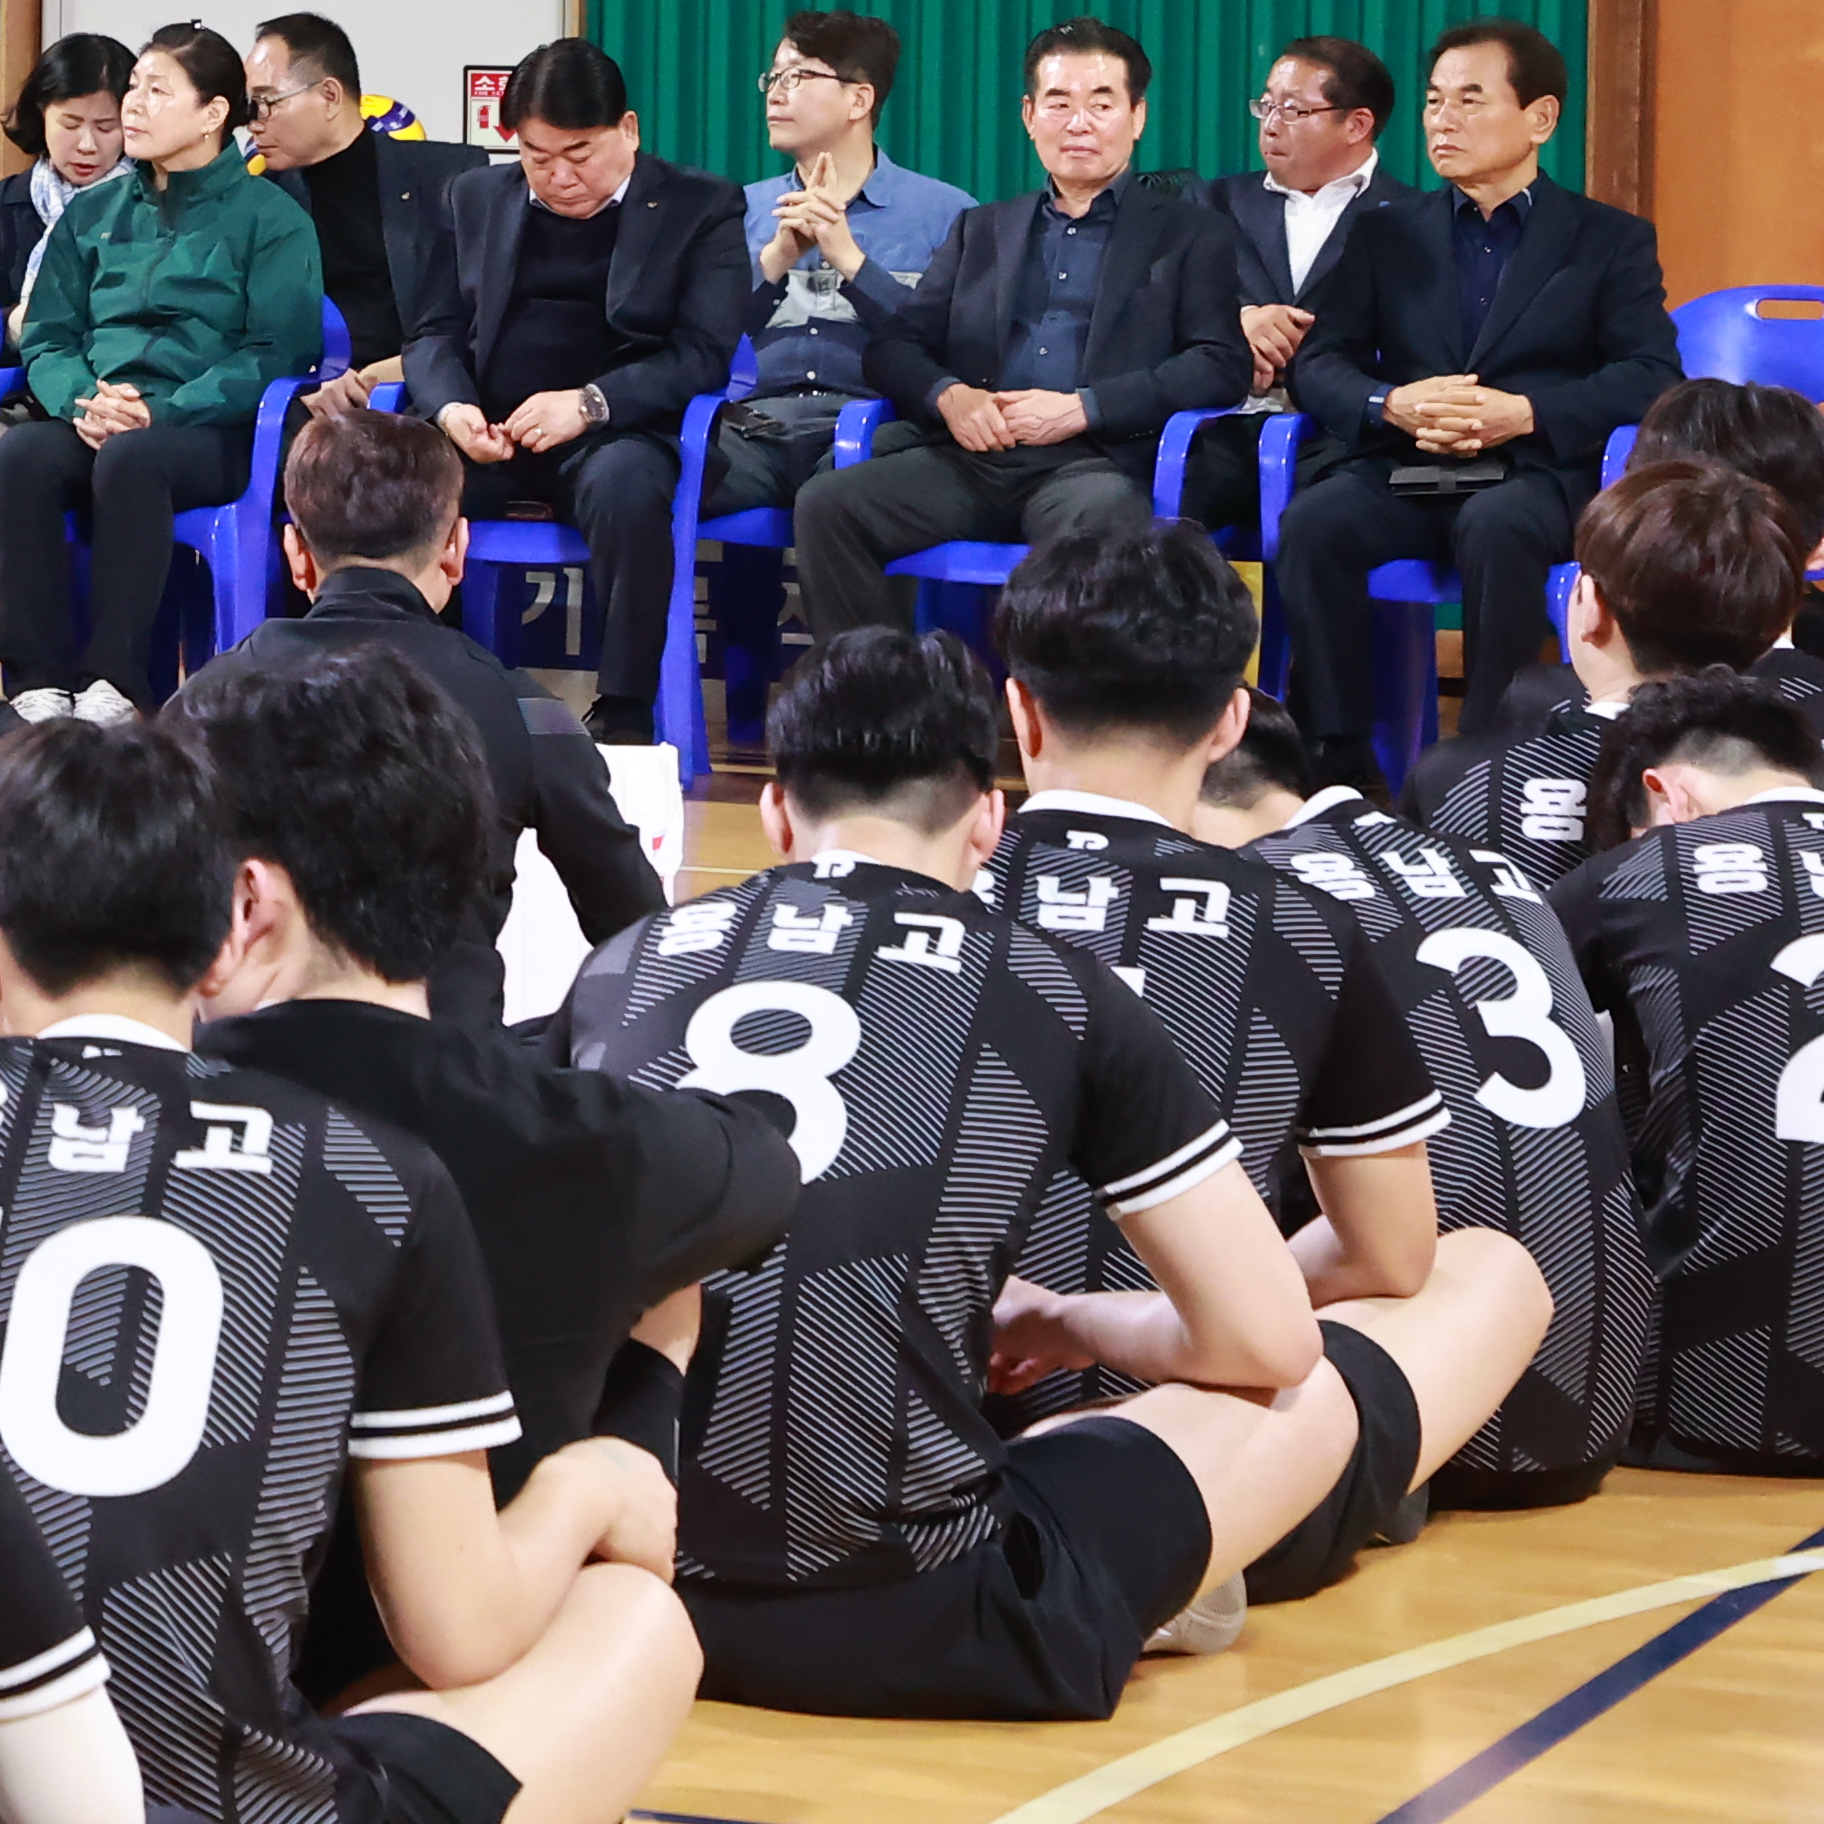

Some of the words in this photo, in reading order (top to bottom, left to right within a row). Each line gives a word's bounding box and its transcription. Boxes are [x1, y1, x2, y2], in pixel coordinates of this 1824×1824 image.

[657, 900, 966, 975] 용남고
[1415, 927, 1587, 1130] 3
[673, 980, 861, 1186] 8
